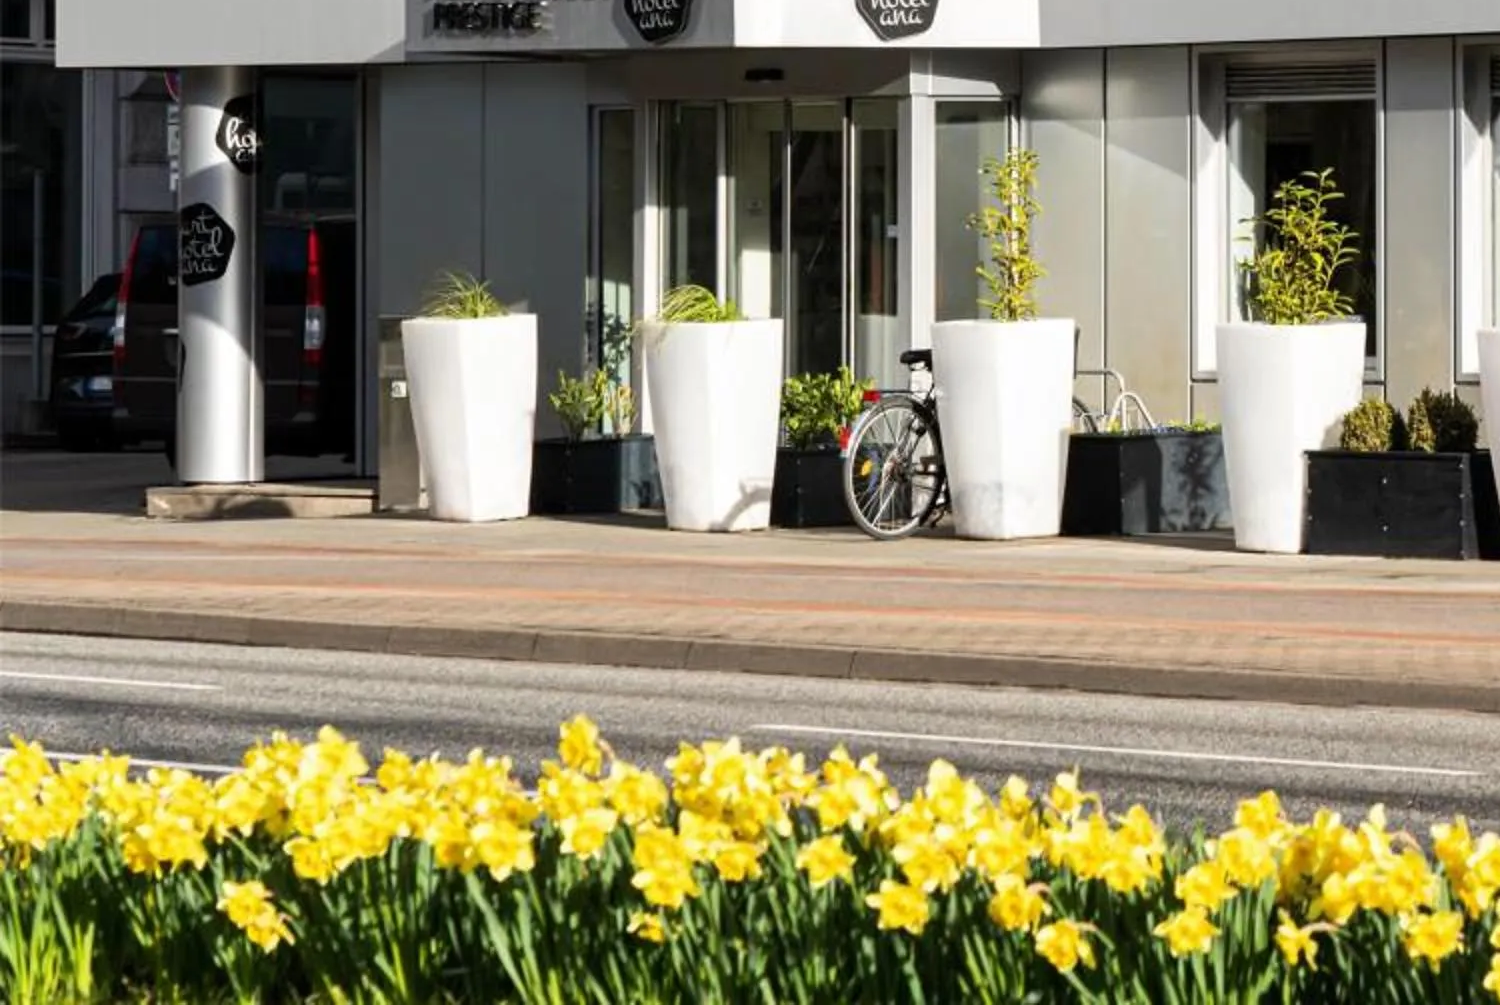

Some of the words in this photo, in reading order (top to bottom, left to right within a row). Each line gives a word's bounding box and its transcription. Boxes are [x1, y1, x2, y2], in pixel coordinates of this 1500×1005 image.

[433, 0, 548, 31] PRESTIGE
[640, 10, 674, 29] ana
[880, 8, 924, 26] ana
[181, 226, 225, 257] otel
